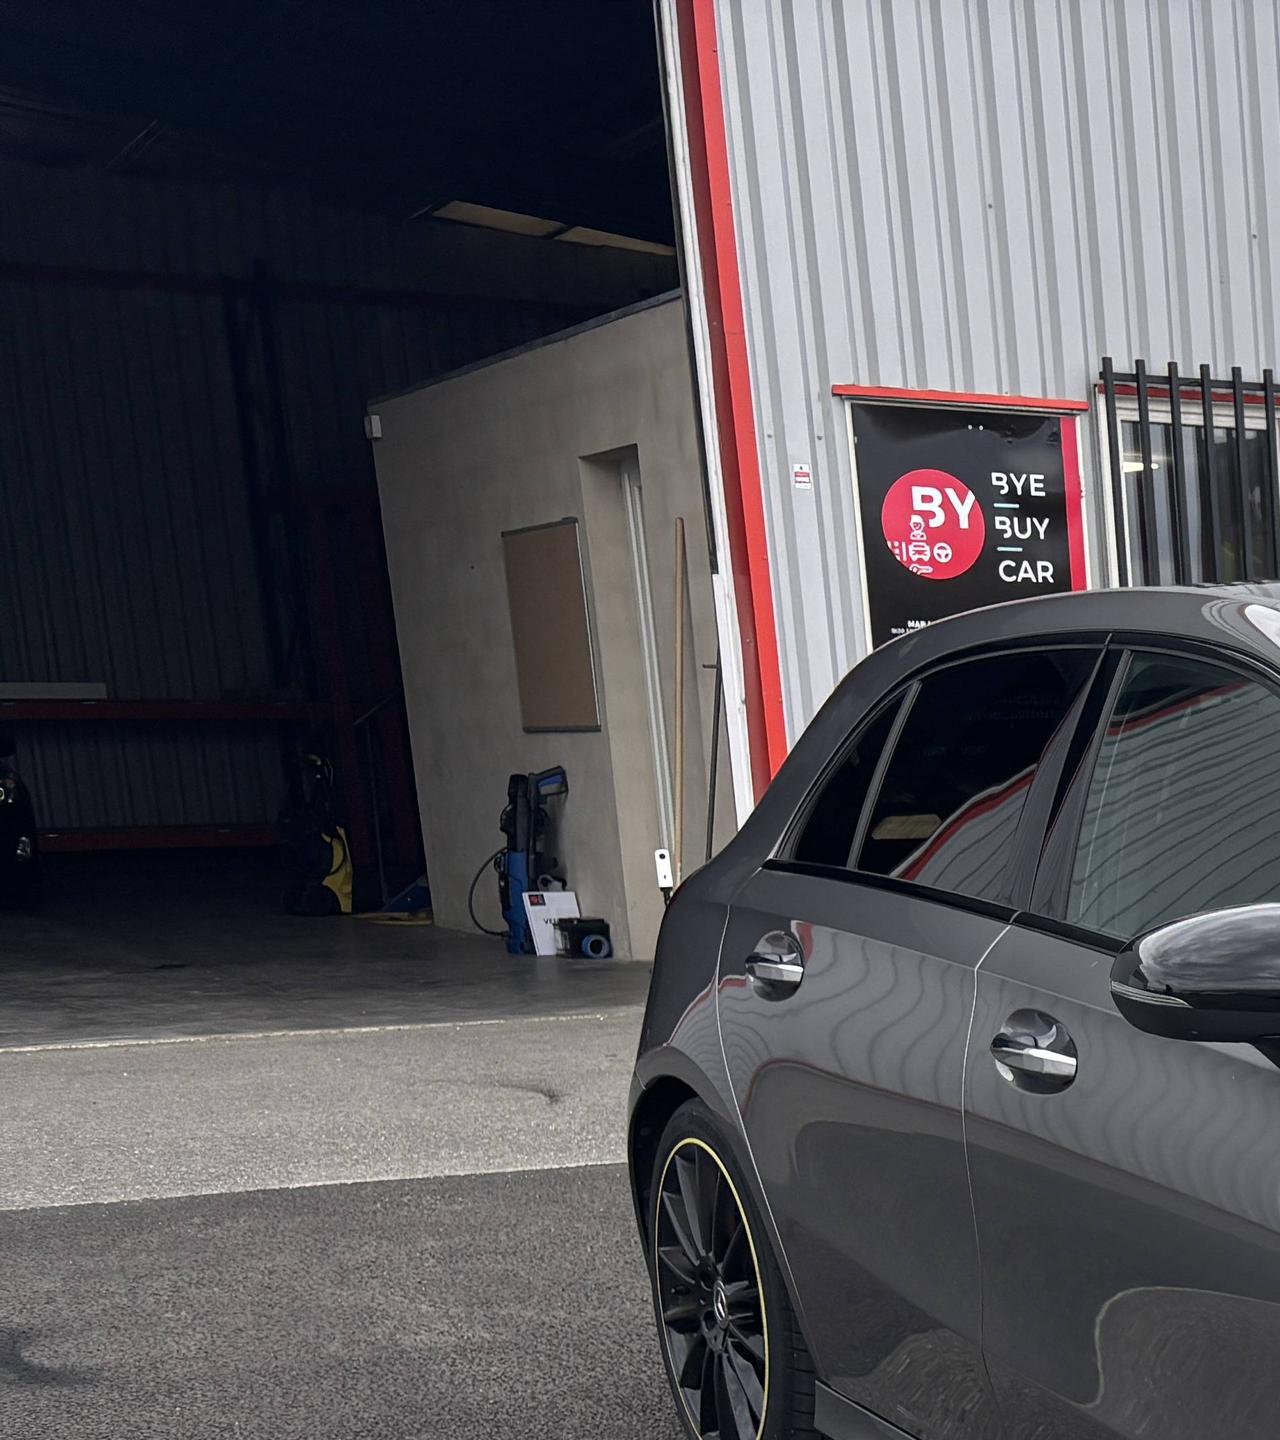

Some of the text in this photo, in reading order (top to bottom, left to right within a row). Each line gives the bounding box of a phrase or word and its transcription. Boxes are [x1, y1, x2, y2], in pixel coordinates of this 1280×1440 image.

[991, 472, 1046, 497] BYE
[911, 485, 976, 529] BY
[994, 515, 1050, 540] BUY
[998, 560, 1054, 583] CAR
